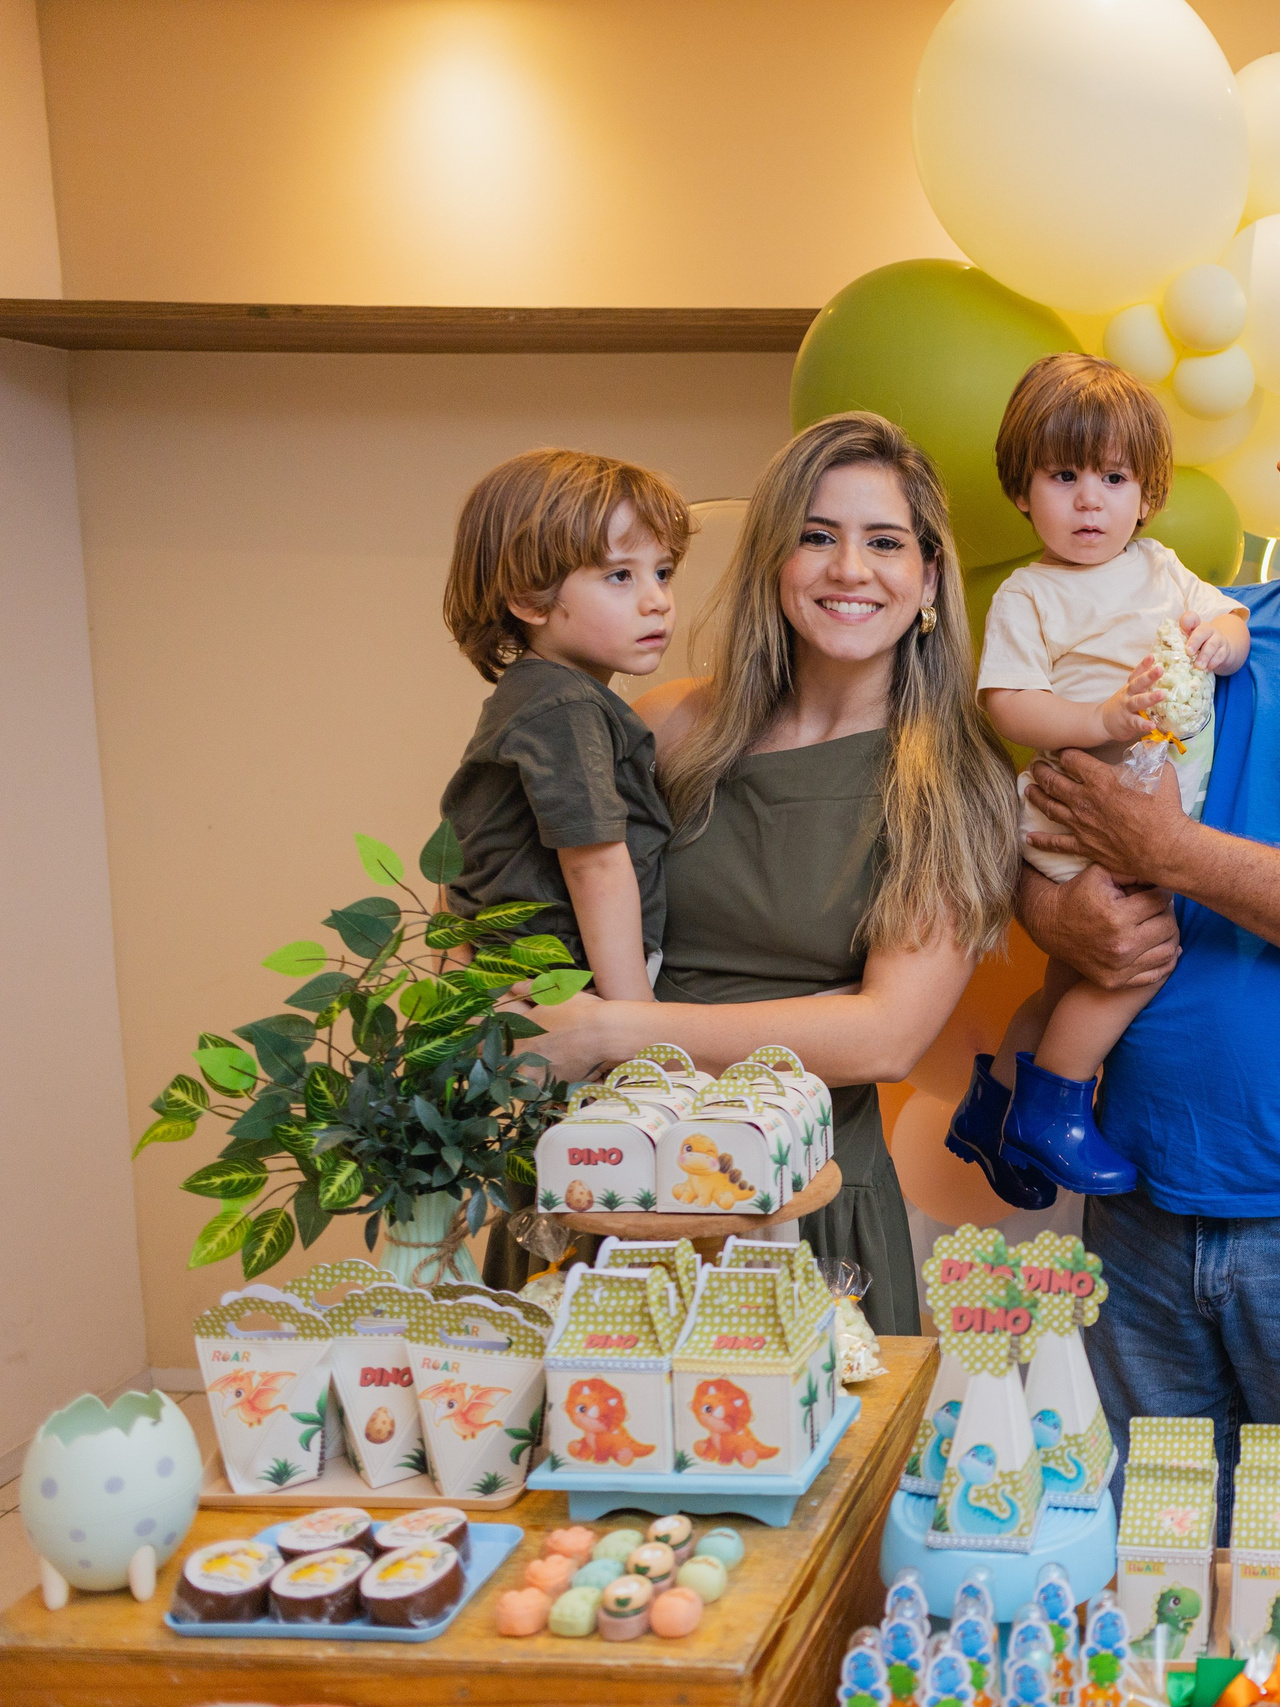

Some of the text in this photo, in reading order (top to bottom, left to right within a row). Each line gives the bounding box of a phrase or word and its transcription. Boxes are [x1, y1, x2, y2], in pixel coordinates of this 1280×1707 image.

[568, 1147, 624, 1166] DINO
[1022, 1265, 1096, 1298] DINO
[952, 1305, 1033, 1335] DINO
[584, 1334, 639, 1349] DINO
[713, 1335, 767, 1350] DINO
[211, 1351, 251, 1363] ROAR
[421, 1357, 461, 1374] ROAR
[359, 1366, 414, 1388] DINO
